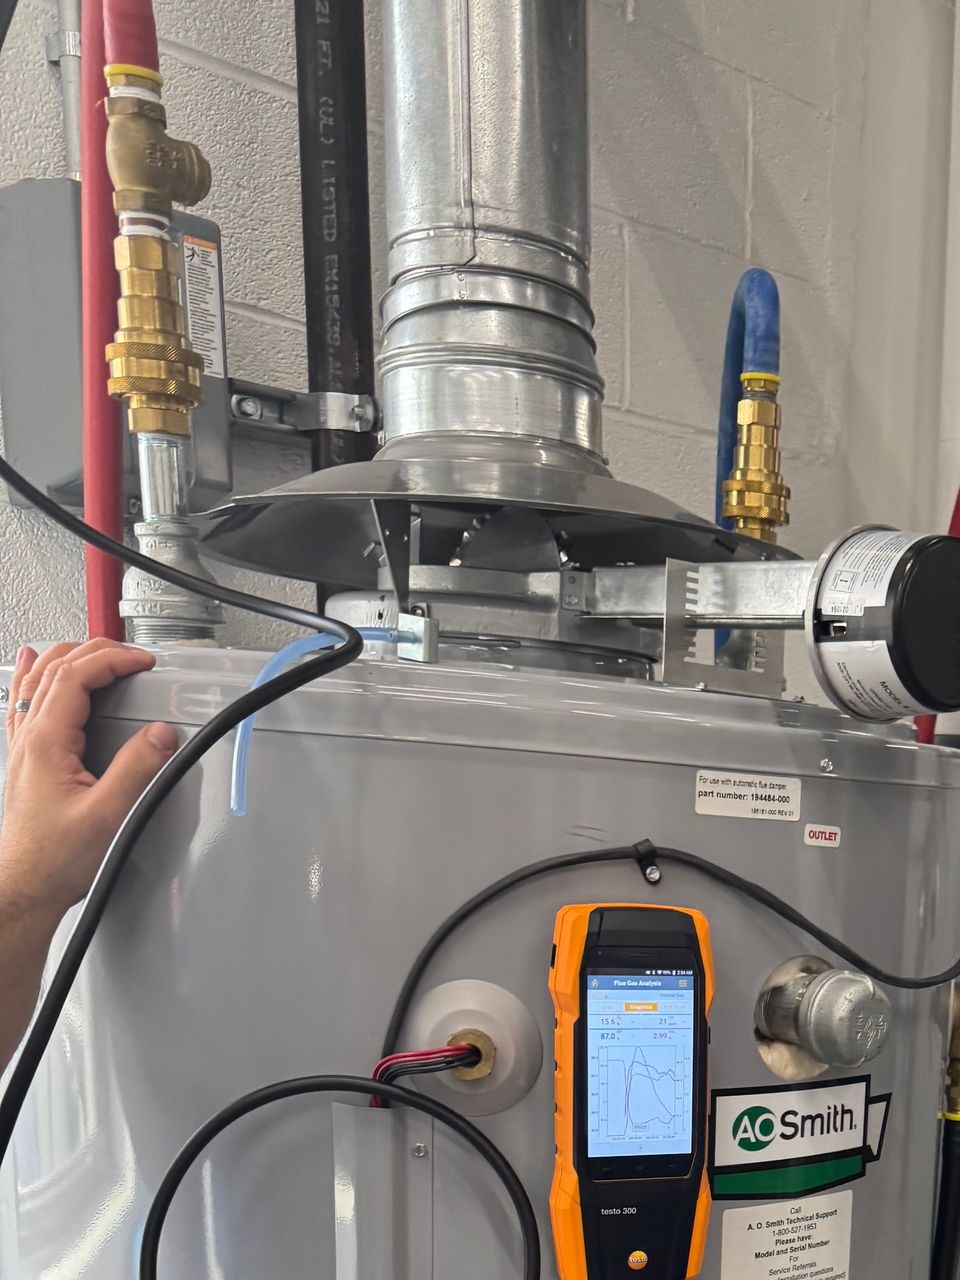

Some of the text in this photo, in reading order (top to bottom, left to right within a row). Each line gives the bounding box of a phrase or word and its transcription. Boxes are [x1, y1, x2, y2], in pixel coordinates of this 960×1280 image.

[320, 159, 338, 243] LISTED
[699, 775, 709, 784] For
[721, 778, 732, 787] with
[733, 779, 758, 788] automatic
[758, 780, 768, 789] flue
[698, 790, 715, 798] part
[716, 791, 748, 801] number:
[808, 830, 838, 842] OUTLET
[600, 1207, 637, 1216] testo 300
[789, 1206, 802, 1215] Call
[747, 1223, 755, 1231] A.
[765, 1219, 785, 1229] Smith
[786, 1213, 815, 1225] Technical
[815, 1209, 838, 1220] Support
[772, 1222, 817, 1237] 1-800-527-1953
[775, 1234, 813, 1246] Please have:
[754, 1239, 830, 1260] Model and Serial Number
[788, 1255, 800, 1264] For
[768, 1261, 817, 1277] Service Referrals
[809, 1266, 834, 1279] questions
